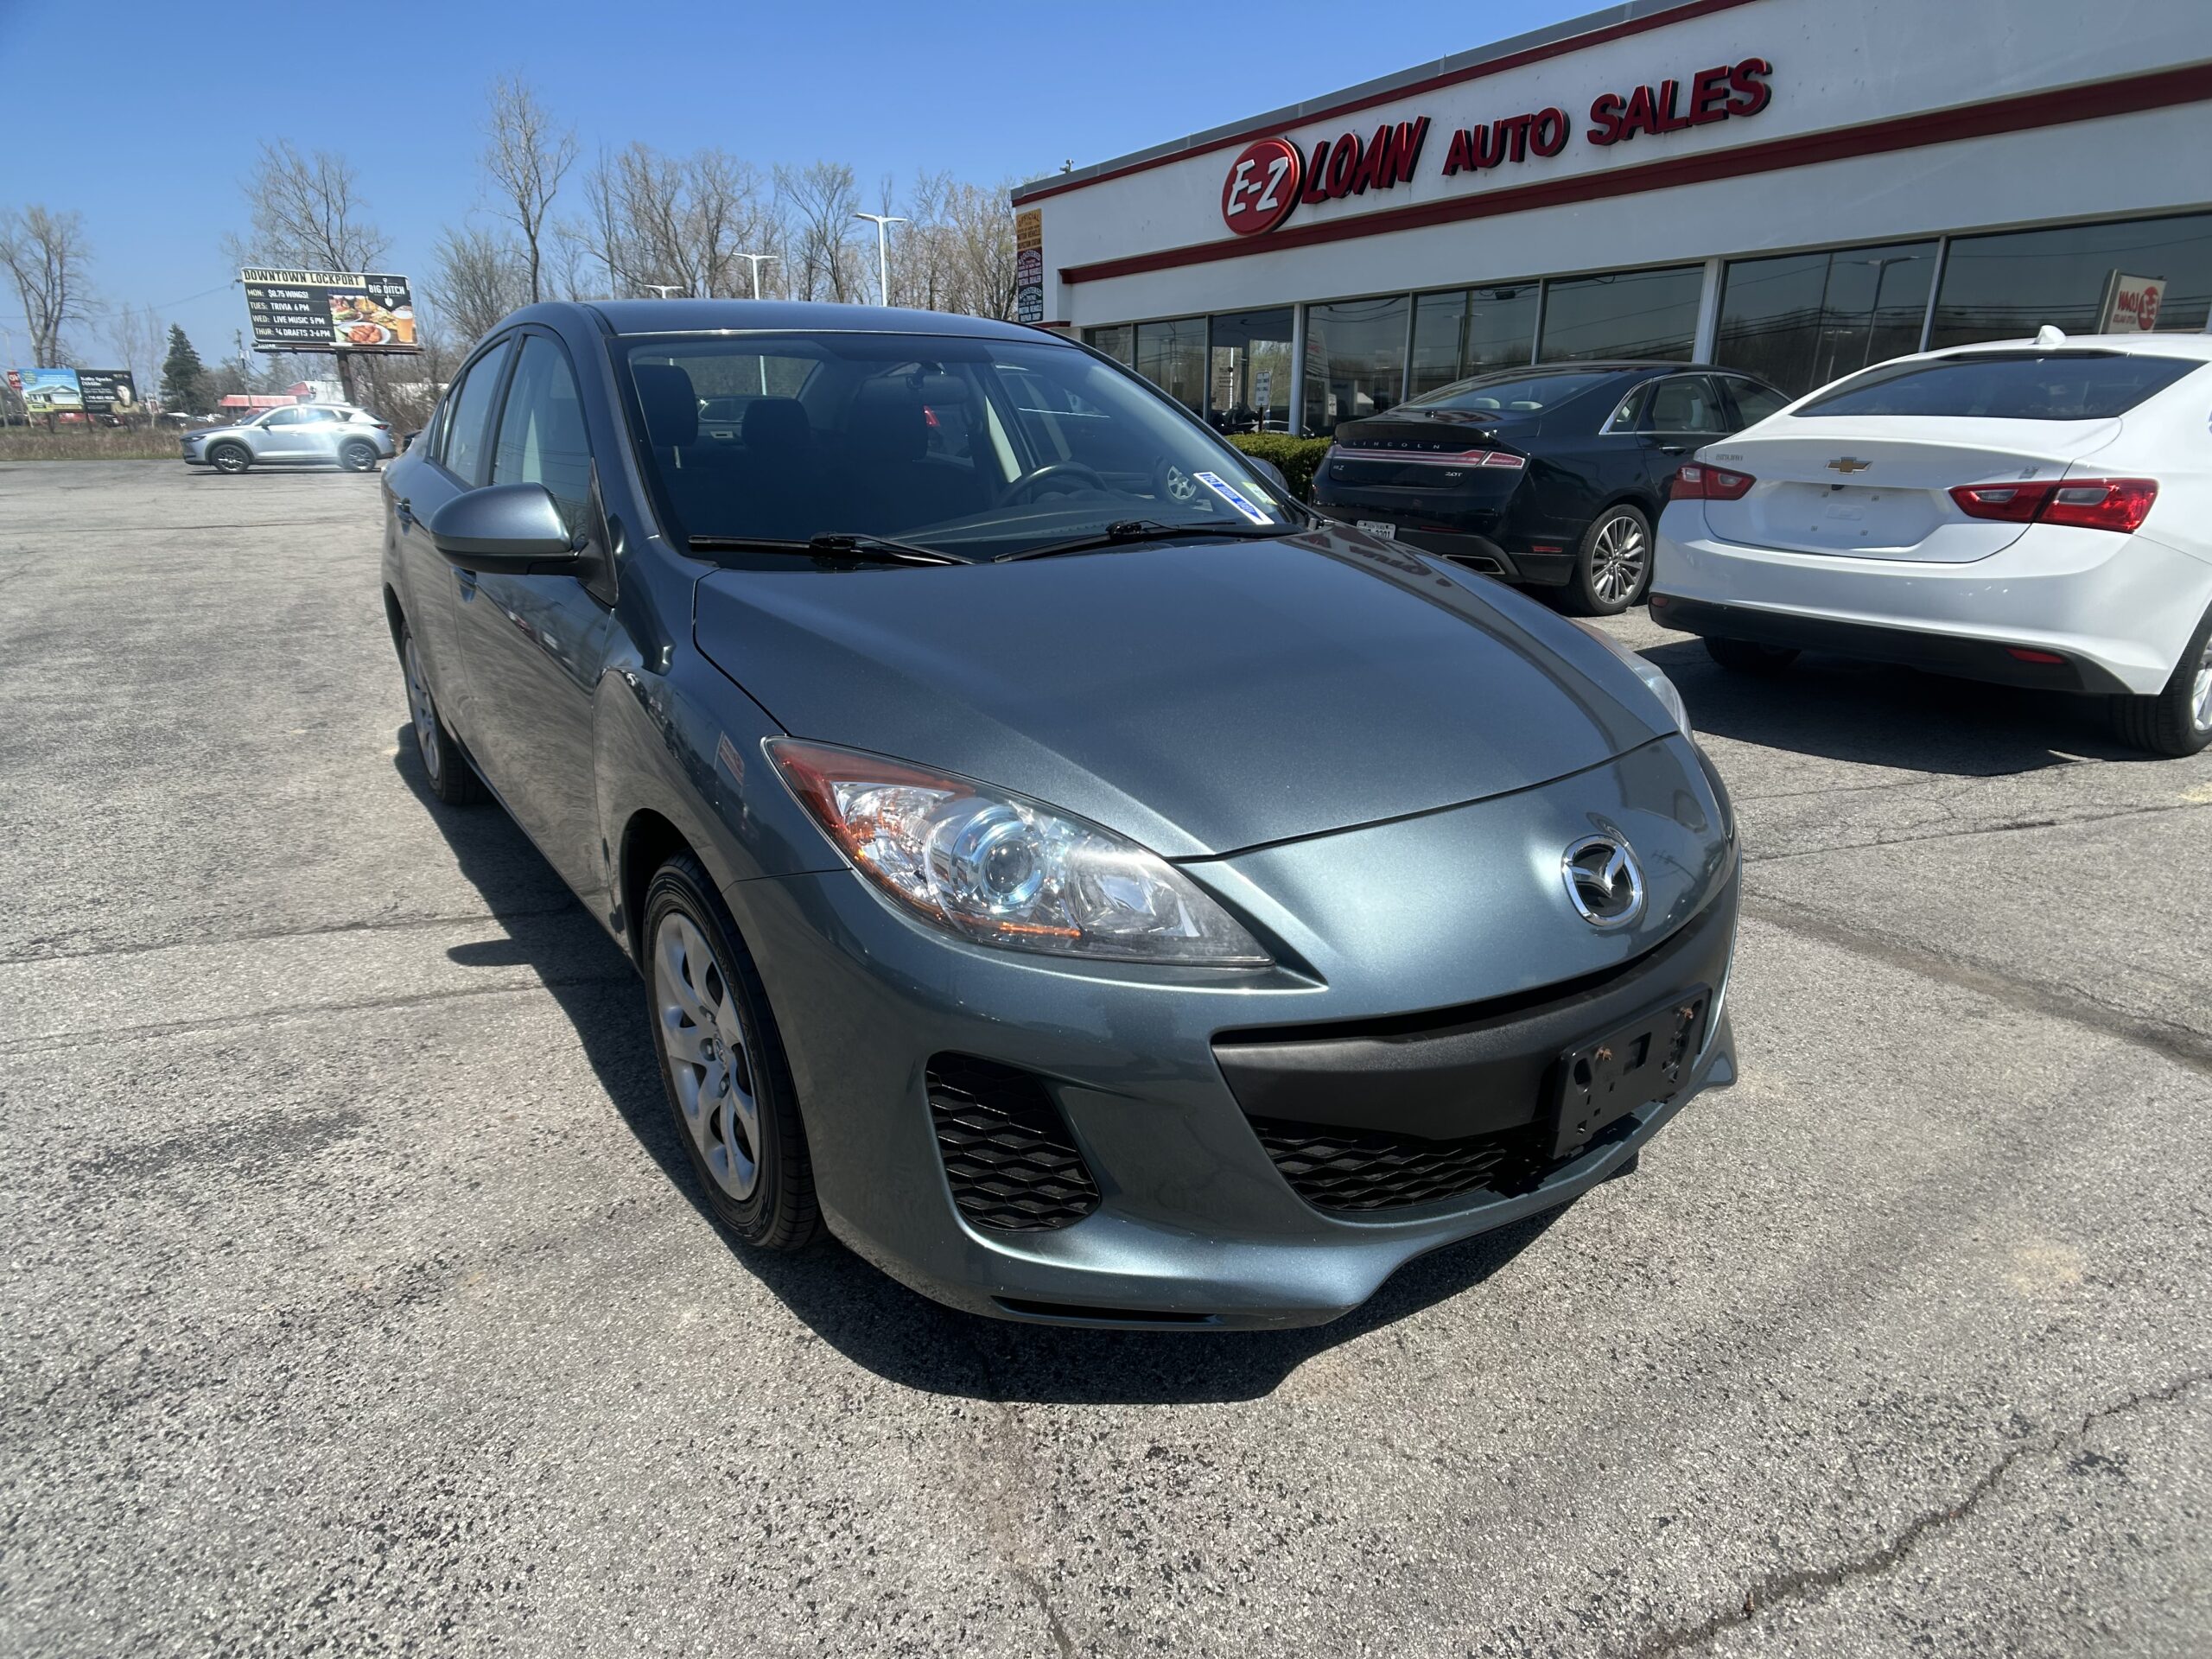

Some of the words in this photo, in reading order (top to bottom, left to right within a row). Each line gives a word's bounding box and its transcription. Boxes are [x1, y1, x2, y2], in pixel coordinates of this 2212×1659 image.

[1441, 106, 1570, 175] AUTO
[1586, 56, 1773, 147] SALES
[1227, 156, 1289, 217] E-Z
[1300, 115, 1431, 205] LOAN
[244, 270, 307, 283] DOWNTOWN
[311, 272, 359, 285] LOCKPORT
[368, 284, 382, 293] BIG
[383, 285, 405, 295] DITCH
